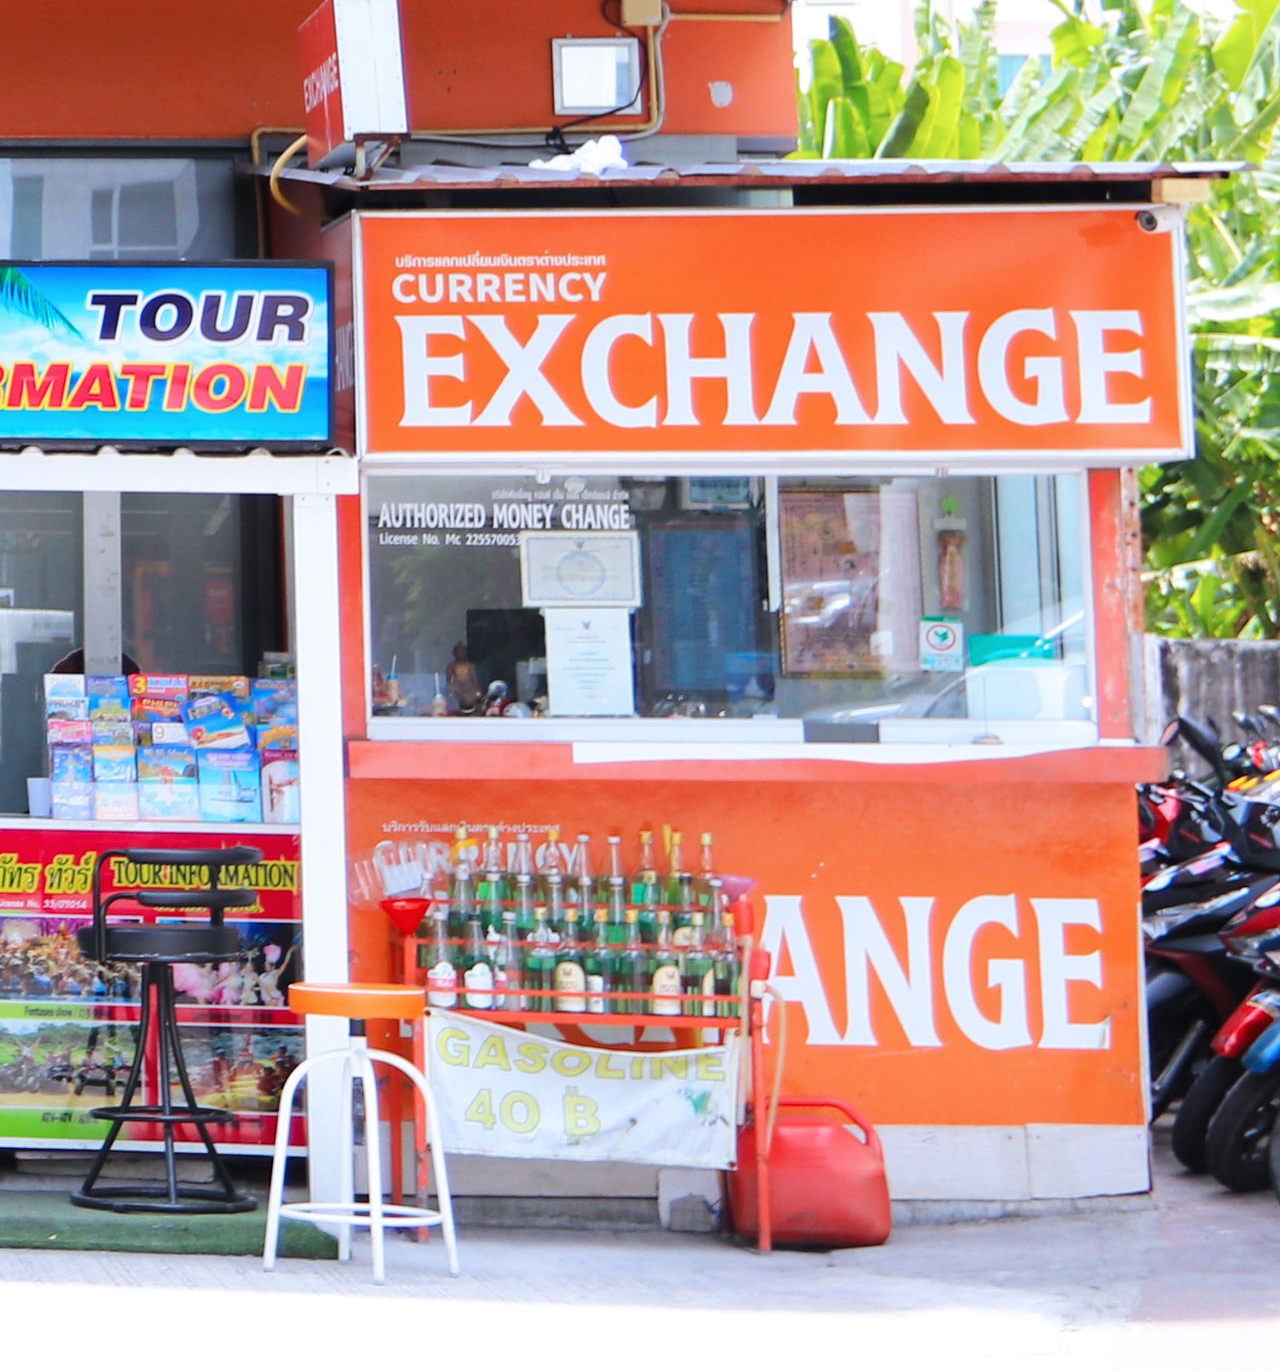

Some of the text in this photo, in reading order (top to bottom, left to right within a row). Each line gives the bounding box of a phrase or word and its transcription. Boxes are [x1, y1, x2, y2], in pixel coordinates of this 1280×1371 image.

[391, 272, 608, 303] CURRENCY
[89, 292, 311, 343] TOUR
[393, 307, 1152, 428] EXCHANGE
[378, 502, 630, 530] AUTHORIZED MONEY CHANGE
[379, 533, 418, 546] License
[421, 534, 440, 546] No.
[445, 534, 461, 546] Mc
[46, 851, 96, 894] ทัวร์
[113, 860, 166, 884] TOUR
[168, 863, 295, 888] INFOMATION
[435, 1027, 726, 1082] GASOLINE
[465, 1088, 541, 1134] 40
